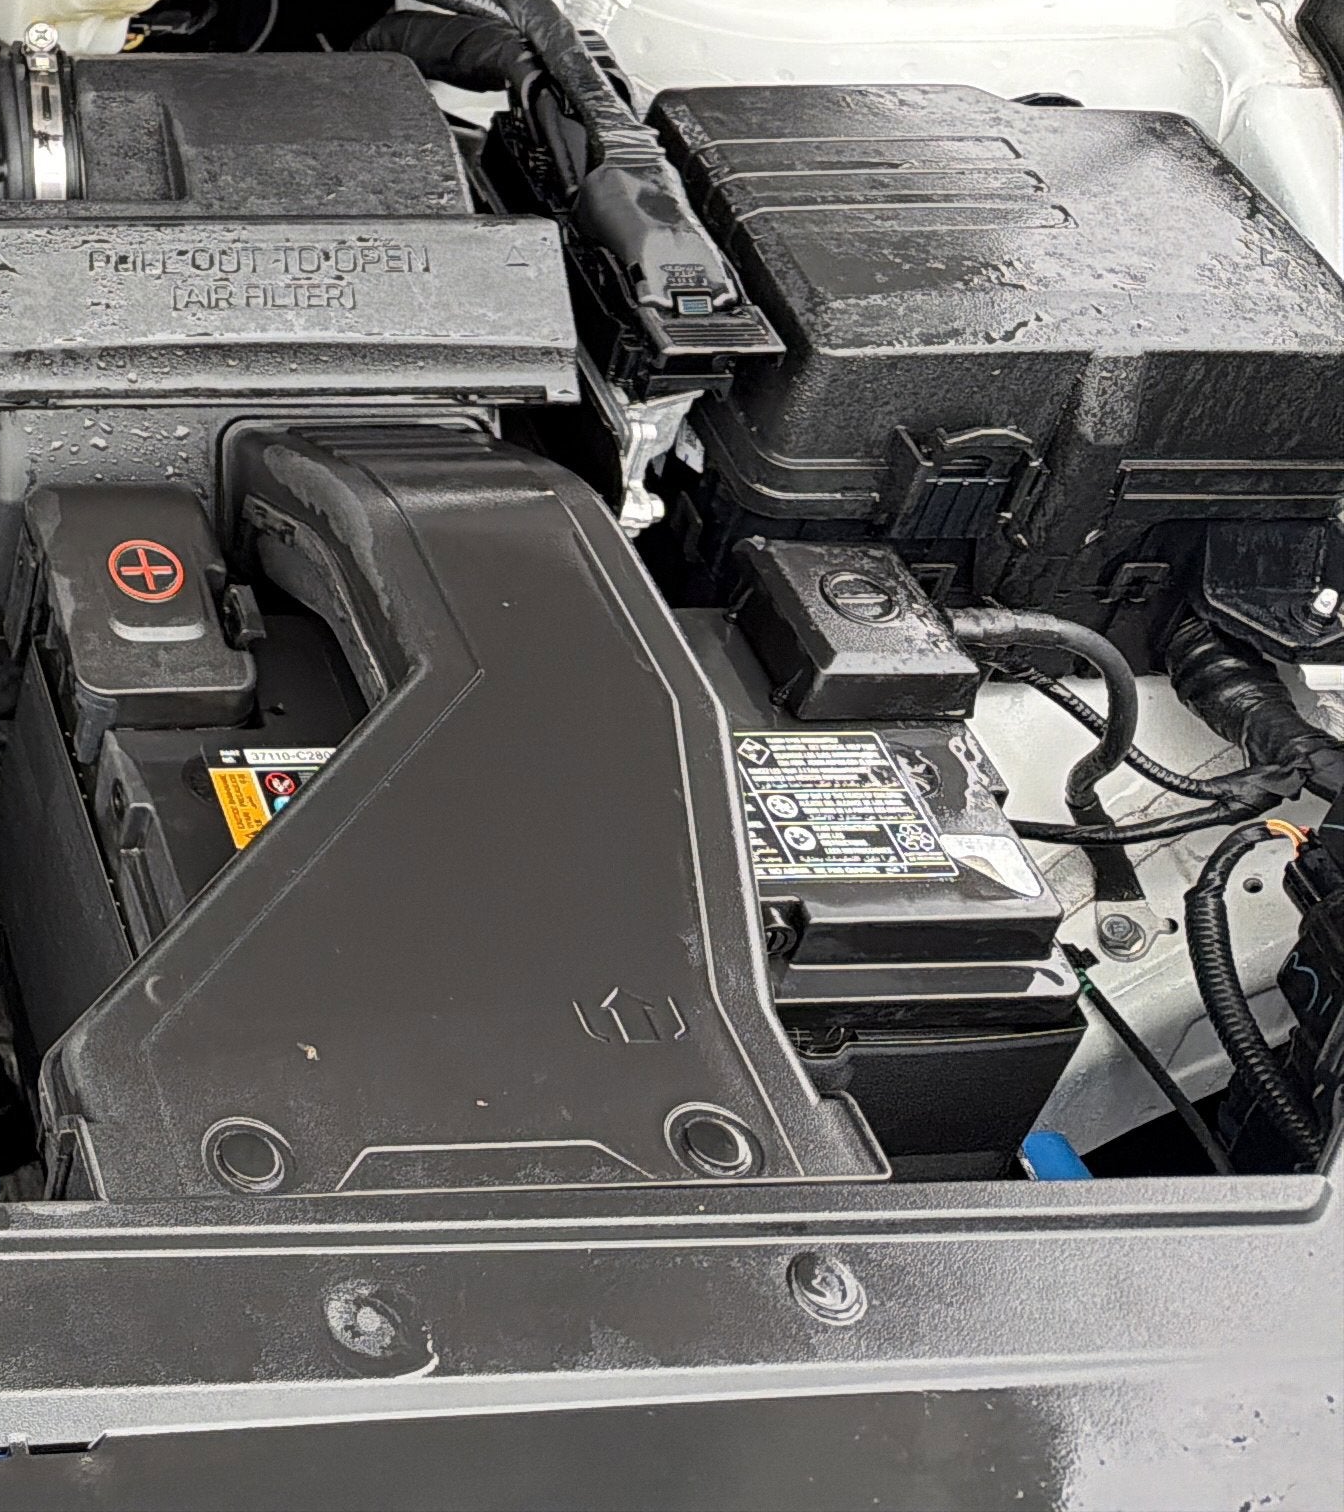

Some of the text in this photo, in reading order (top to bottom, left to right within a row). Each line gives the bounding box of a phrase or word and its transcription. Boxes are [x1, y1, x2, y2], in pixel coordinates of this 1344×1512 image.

[88, 245, 431, 275] PULL OUT TO OPEN
